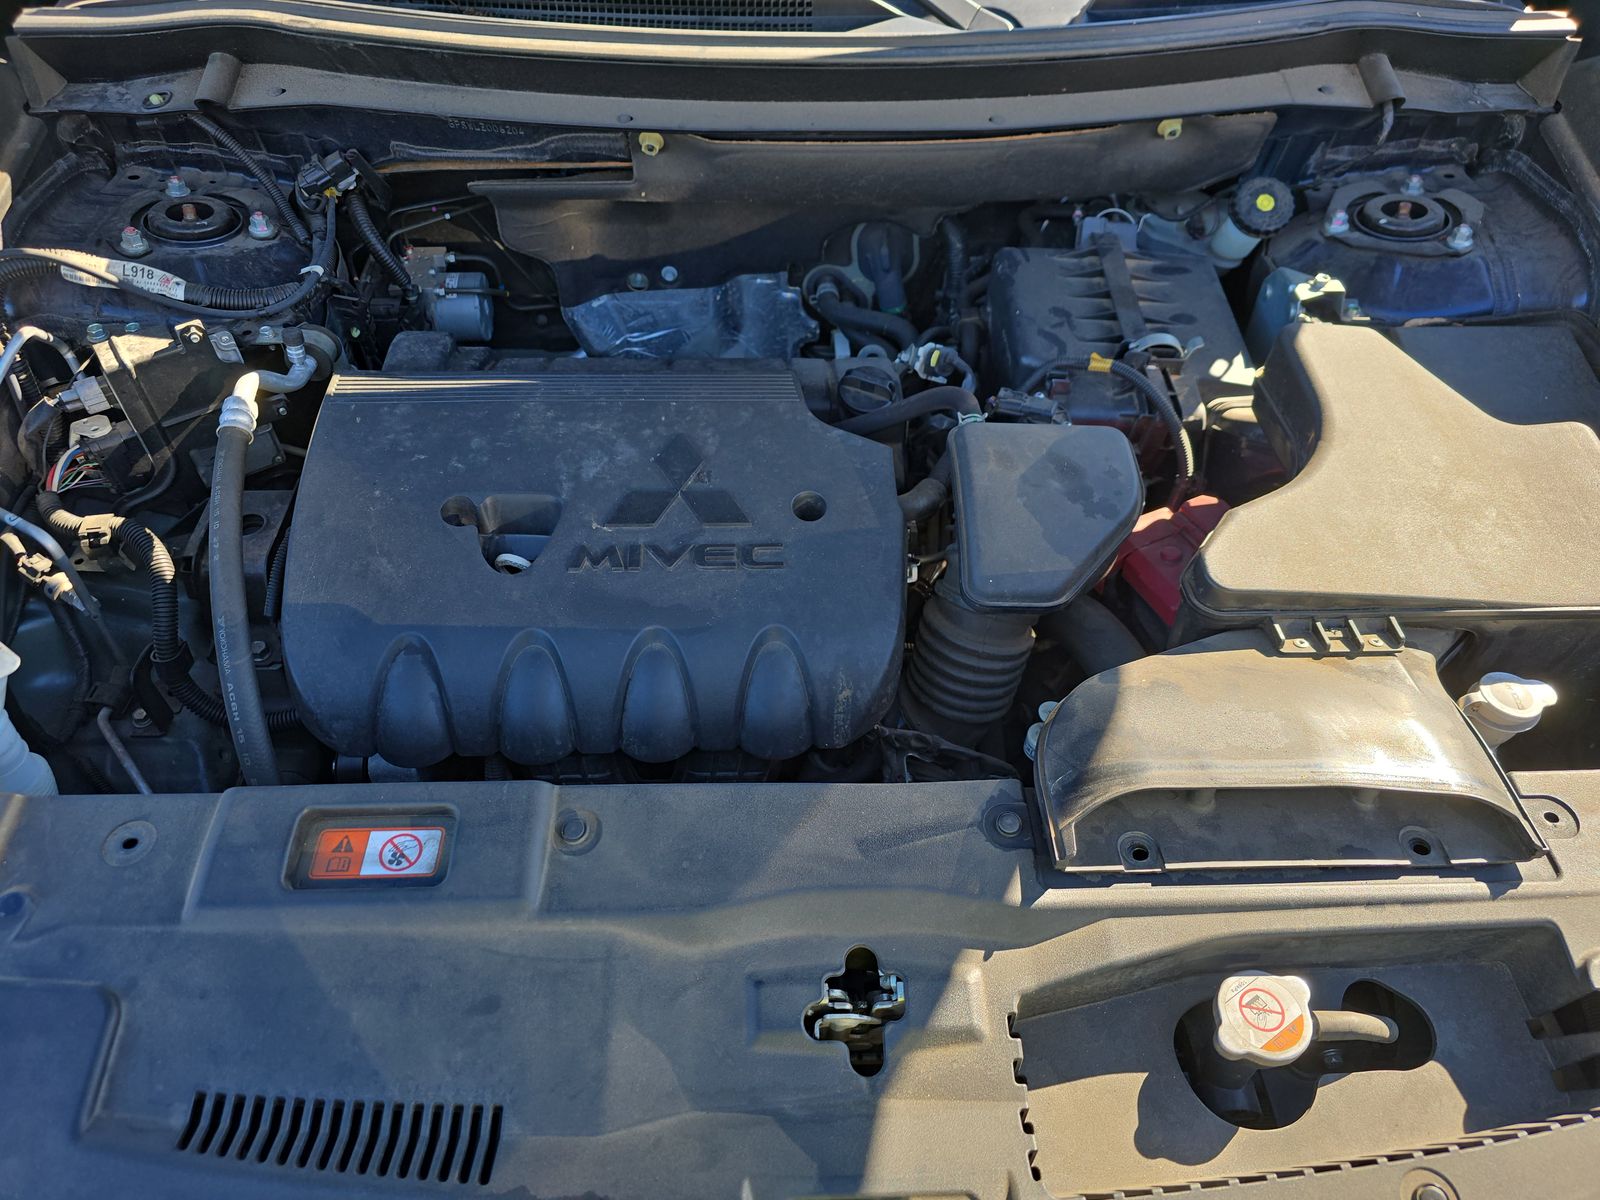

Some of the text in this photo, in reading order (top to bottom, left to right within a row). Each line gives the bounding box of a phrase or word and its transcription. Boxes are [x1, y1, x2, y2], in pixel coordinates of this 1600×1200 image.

[122, 264, 154, 280] L918
[566, 543, 785, 574] MIVEC
[236, 728, 246, 744] 15
